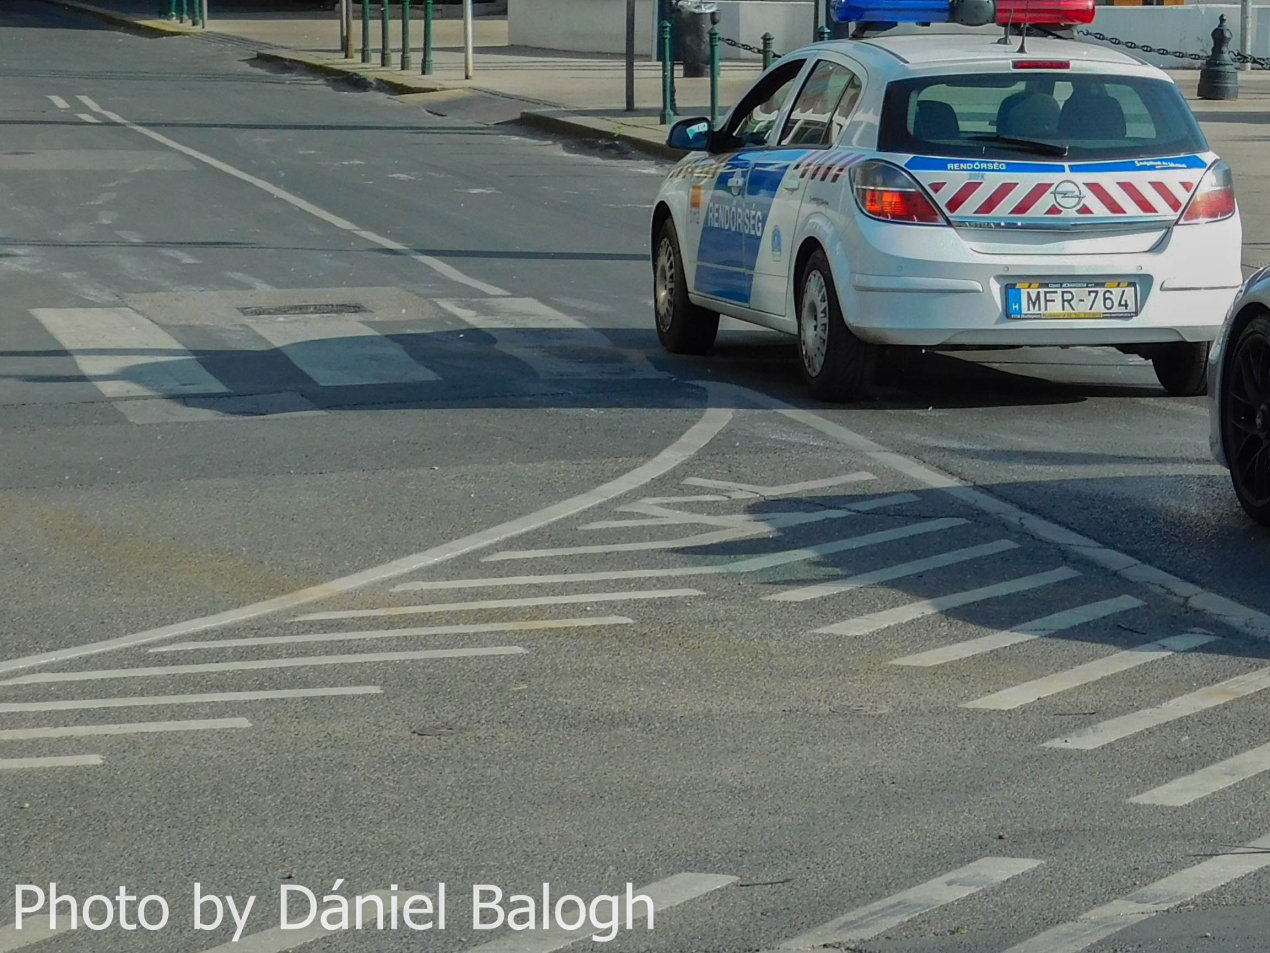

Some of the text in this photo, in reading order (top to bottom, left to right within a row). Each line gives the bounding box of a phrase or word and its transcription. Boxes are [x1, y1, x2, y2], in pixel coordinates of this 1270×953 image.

[947, 161, 1006, 170] RENDŐRSÉG
[707, 200, 763, 237] RENDŐRSÉG
[1012, 303, 1019, 311] H
[1026, 289, 1130, 312] MFR-764
